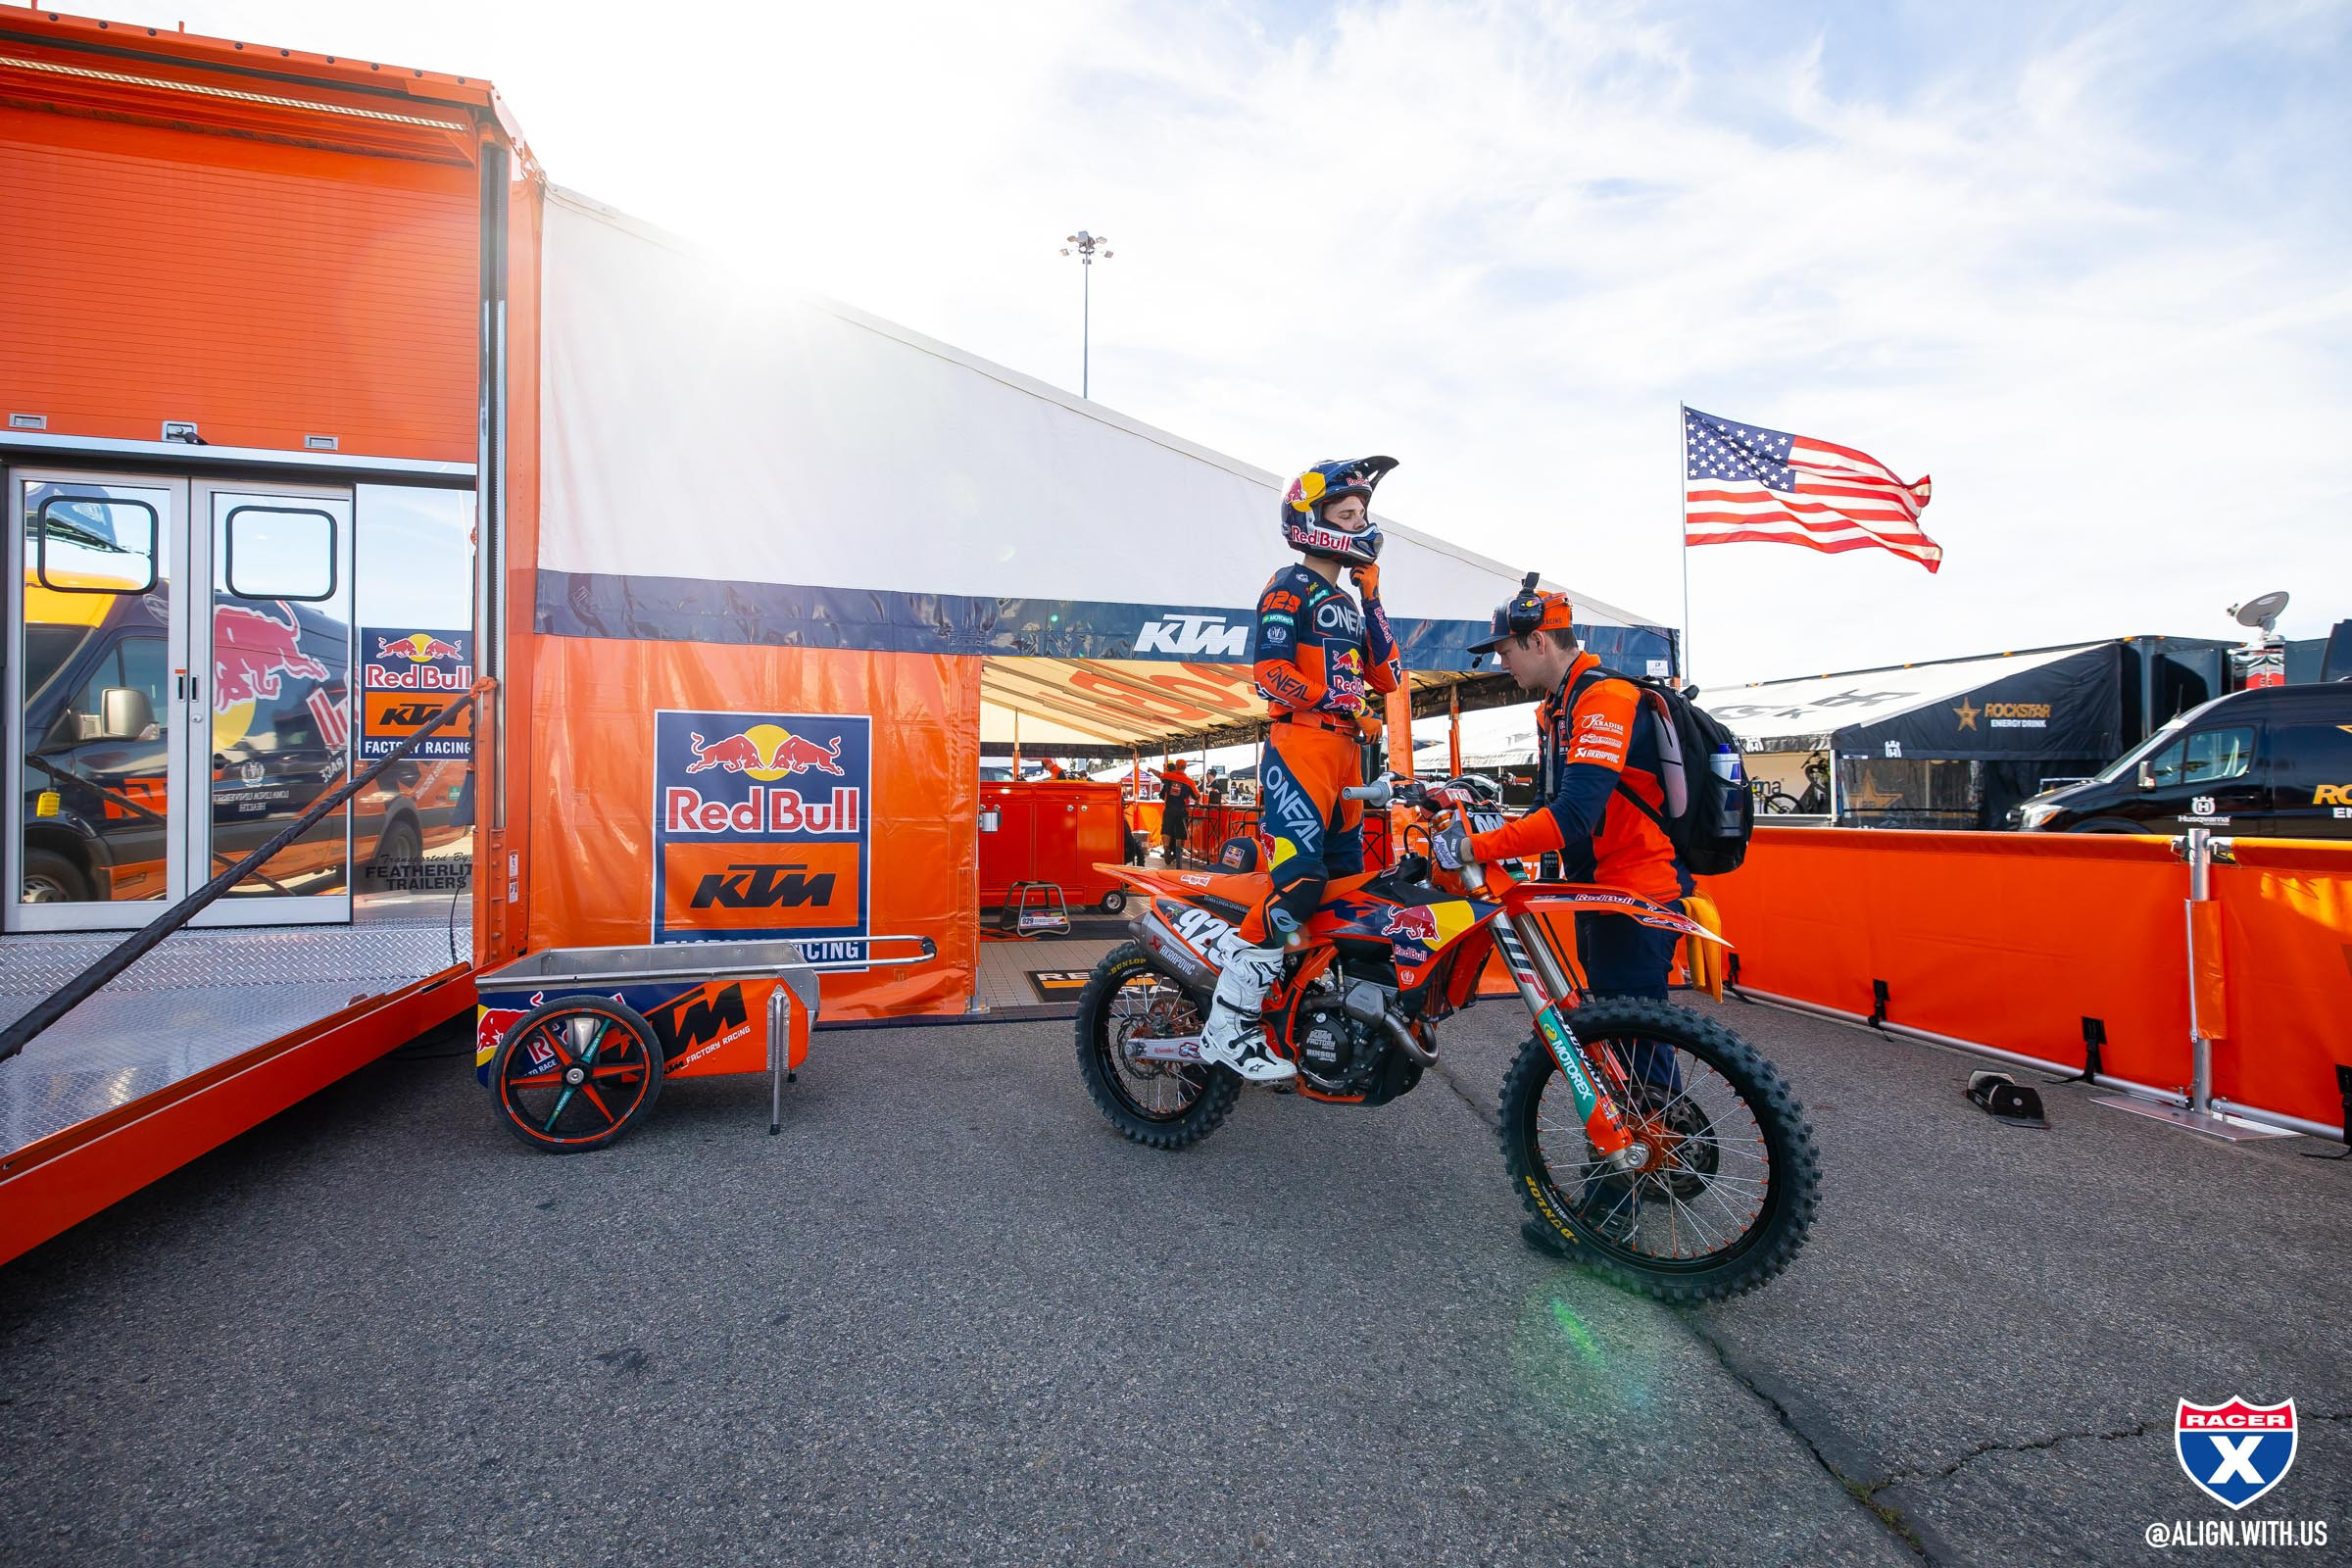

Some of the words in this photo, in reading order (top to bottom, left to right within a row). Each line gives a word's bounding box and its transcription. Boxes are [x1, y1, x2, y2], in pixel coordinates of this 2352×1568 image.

[1292, 525, 1317, 545] Red
[1319, 531, 1351, 552] Bull
[1262, 591, 1301, 613] 929
[1133, 613, 1250, 656] KTM
[366, 664, 419, 688] Red
[421, 665, 471, 689] Bull
[1984, 703, 2052, 717] ROCKSTAR
[365, 741, 422, 754] FACTY
[425, 742, 470, 755] RACING
[665, 786, 764, 833] Red
[768, 787, 860, 833] Bull
[380, 854, 448, 863] Transported
[365, 863, 472, 879] FEATHERLIT
[386, 877, 466, 891] TRAILERS
[690, 864, 836, 908] KTM
[1575, 893, 1605, 903] Red
[1605, 894, 1635, 906] Bull
[1394, 944, 1411, 957] Red
[1411, 948, 1428, 961] Bull
[1110, 957, 1146, 974] DUNLOP
[538, 1059, 558, 1073] RACE
[1552, 1039, 1592, 1102] MOTOREX
[1526, 1176, 1575, 1239] DUNLOP
